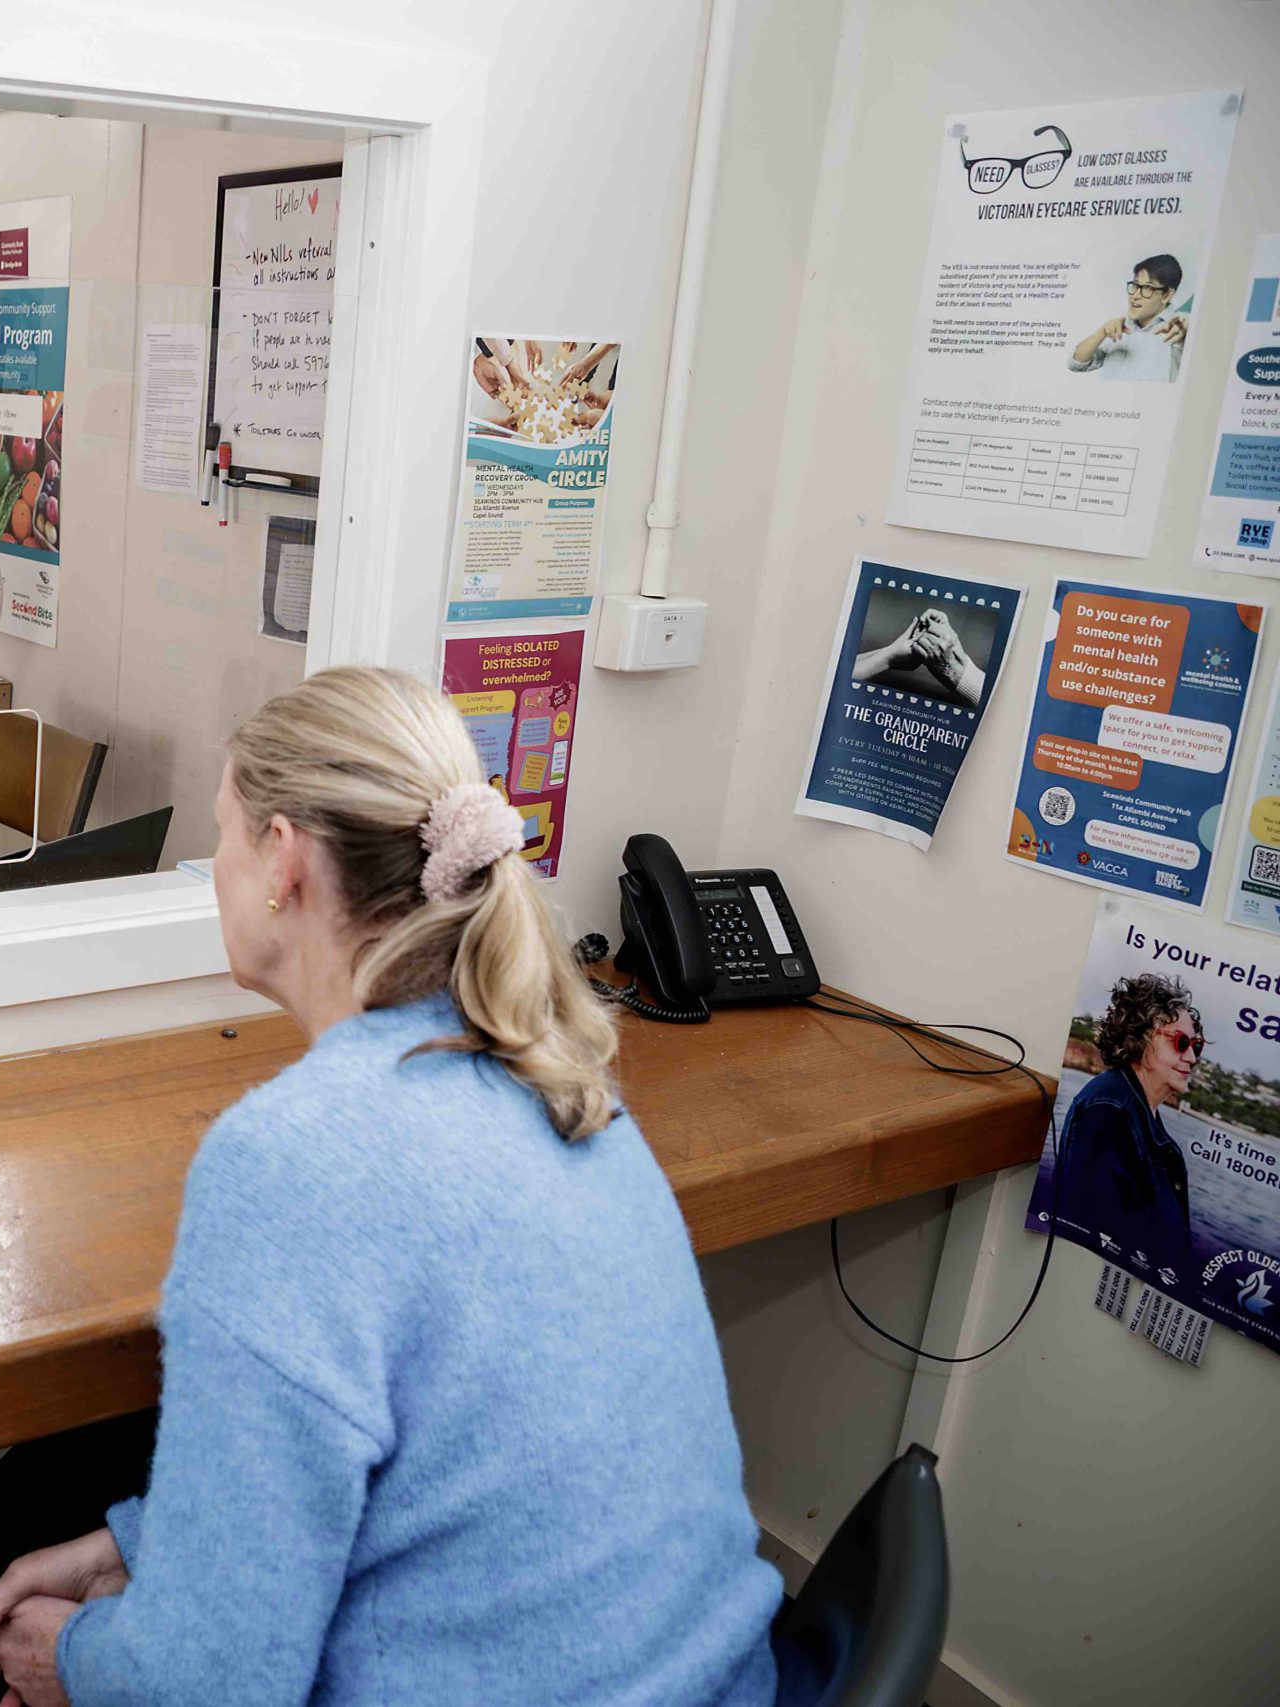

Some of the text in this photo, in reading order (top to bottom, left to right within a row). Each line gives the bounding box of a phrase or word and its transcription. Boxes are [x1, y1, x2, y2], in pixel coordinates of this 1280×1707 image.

[1078, 150, 1167, 167] LOW COST GLASSES
[974, 160, 1059, 182] NEED GLASSES?
[1074, 171, 1193, 188] ARE AVAILABLE THROUGH THE
[275, 188, 305, 220] Hello!
[978, 197, 1182, 220] VICTORIAN EYECARE SERVICE (VES).
[299, 238, 332, 259] referral
[253, 267, 318, 285] all instructions
[31, 303, 56, 316] Support
[284, 312, 320, 324] FORGET
[4, 326, 52, 350] Program
[1246, 392, 1271, 402] Every
[1241, 408, 1277, 416] Located
[580, 429, 609, 444] THE
[555, 451, 608, 466] AMITY
[547, 471, 606, 487] CIRCLE
[1239, 535, 1268, 545] Op Shop
[1241, 524, 1270, 537] RYE
[1077, 605, 1171, 629] Do you care for
[1076, 626, 1162, 647] someone with
[479, 641, 559, 655] Feeling ISOLATED
[1072, 643, 1158, 667] mental health
[483, 658, 551, 669] DISTRESSED or
[1059, 659, 1166, 687] and/or substance
[482, 671, 551, 685] overwhelmed?
[1061, 679, 1156, 705] use challenges?
[844, 704, 969, 750] THE GRANDPARENT
[1103, 725, 1126, 734] space
[1142, 732, 1158, 740] you
[1171, 738, 1185, 746] get
[1109, 713, 1121, 721] We
[1123, 717, 1143, 726] offer
[1176, 727, 1224, 742] welcoming
[883, 729, 928, 752] CIRCLE
[1135, 799, 1175, 814] Community
[1176, 808, 1191, 816] Hub
[1119, 815, 1166, 830] CAPEL SOUND
[1152, 812, 1178, 823] Avenue
[1092, 860, 1128, 877] VACCA
[1126, 925, 1280, 995] Is your relat
[1236, 1007, 1280, 1043] sa
[1208, 1130, 1276, 1167] It's time
[1189, 1141, 1280, 1189] Call 1800R
[1202, 1250, 1243, 1282] RESPECT
